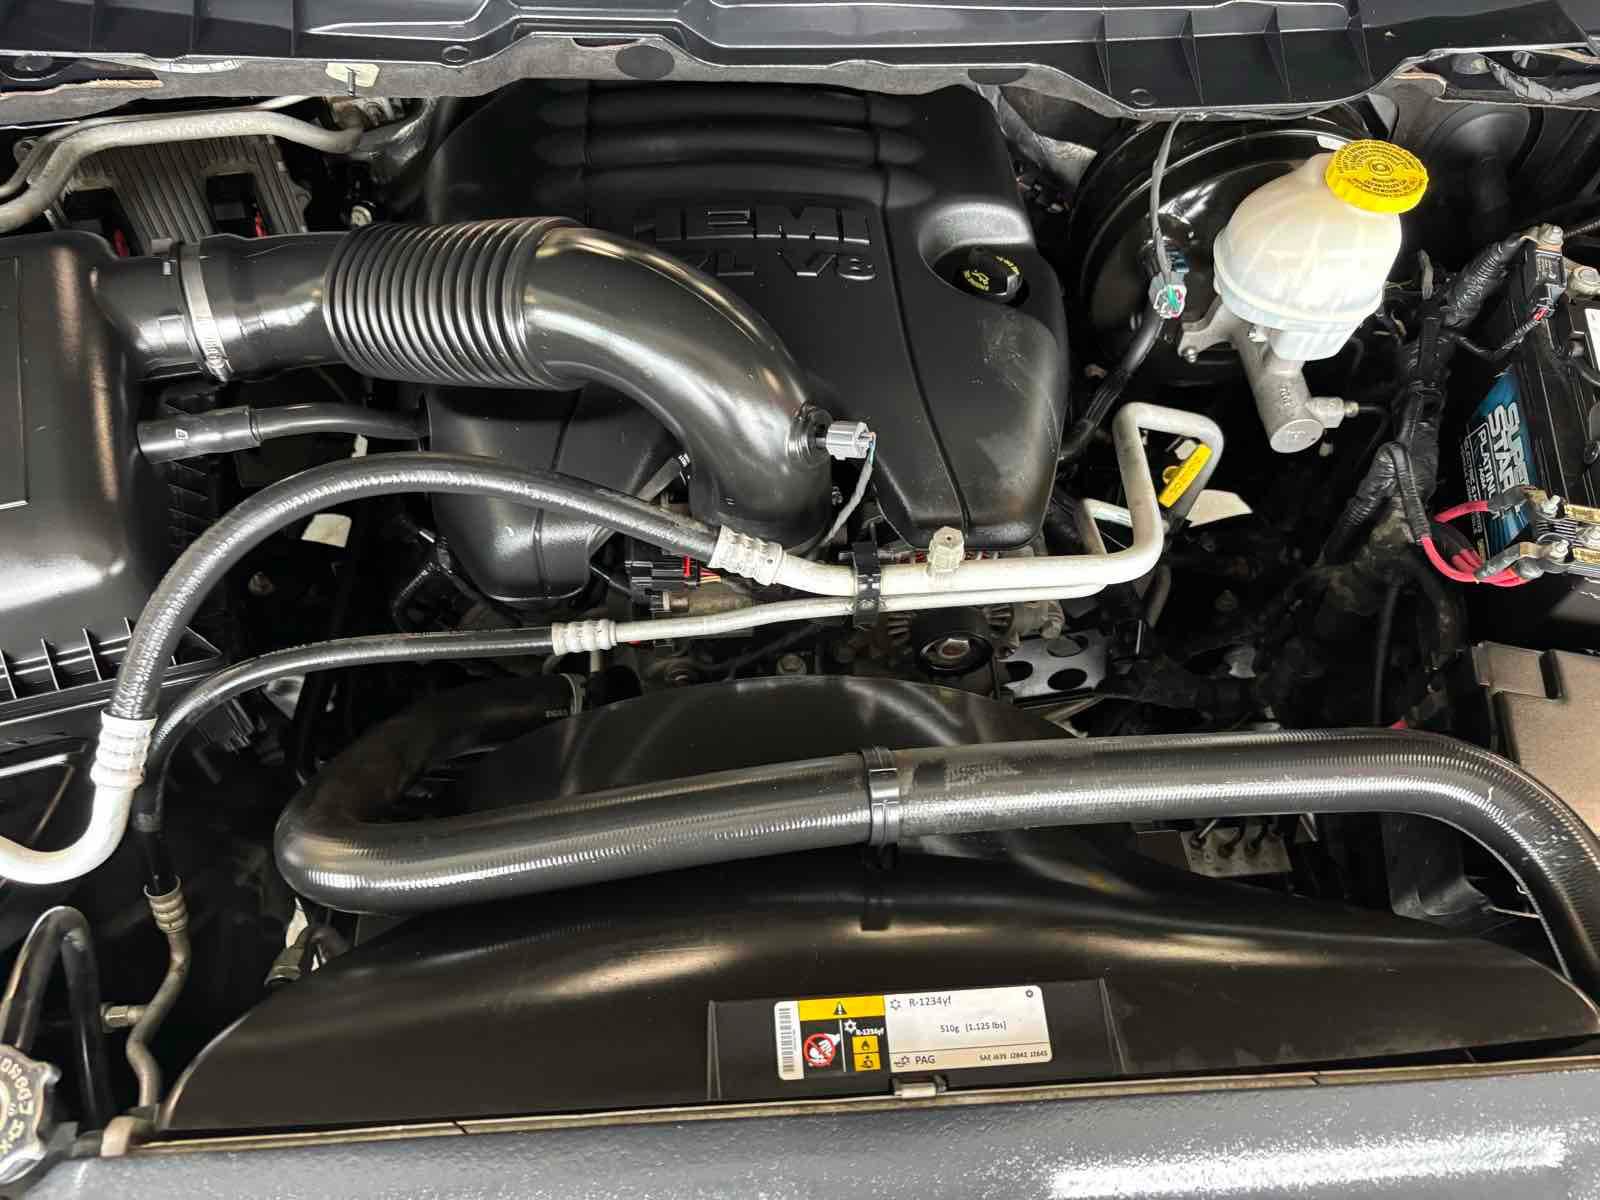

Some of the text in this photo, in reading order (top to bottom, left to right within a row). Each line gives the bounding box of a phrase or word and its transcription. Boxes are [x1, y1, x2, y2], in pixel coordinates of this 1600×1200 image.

[775, 248, 877, 281] V8
[1488, 405, 1515, 496] STAR
[1506, 402, 1529, 490] SUPE
[909, 995, 951, 1008] R-1234yf
[940, 1024, 960, 1034] 510g
[915, 1055, 936, 1065] PAG
